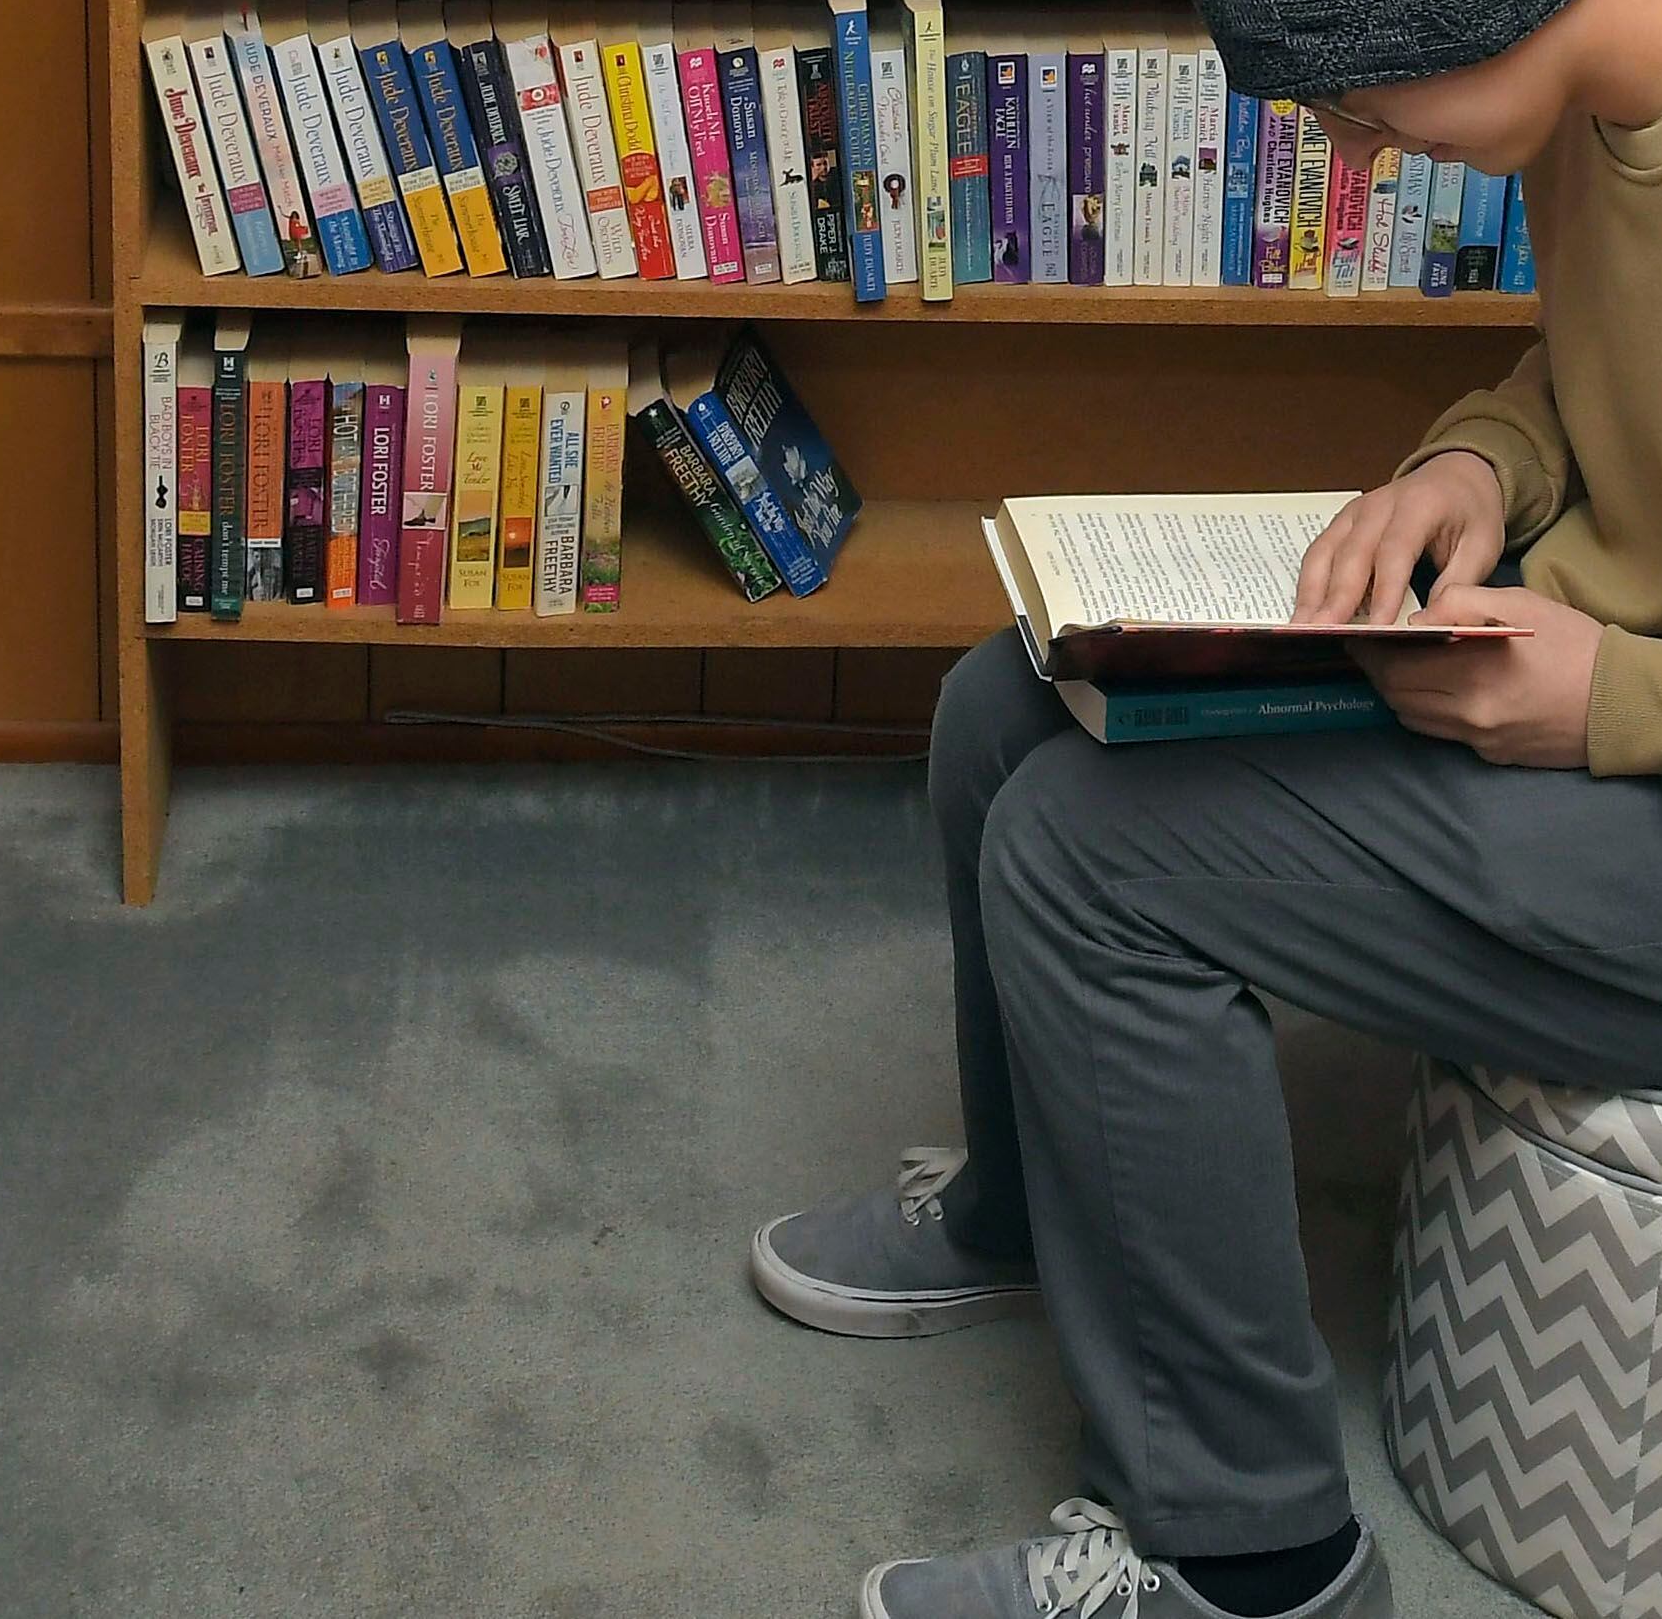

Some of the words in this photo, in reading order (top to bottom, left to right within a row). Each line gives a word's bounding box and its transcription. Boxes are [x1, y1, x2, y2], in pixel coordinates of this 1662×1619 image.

[954, 78, 973, 155] EAGLE
[373, 426, 391, 462] LORI
[369, 465, 390, 517] FOSTER
[663, 446, 712, 513] FREETHY
[675, 444, 719, 498] BARBARA
[1258, 699, 1313, 716] Abnormal
[1314, 697, 1376, 714] Psychology
